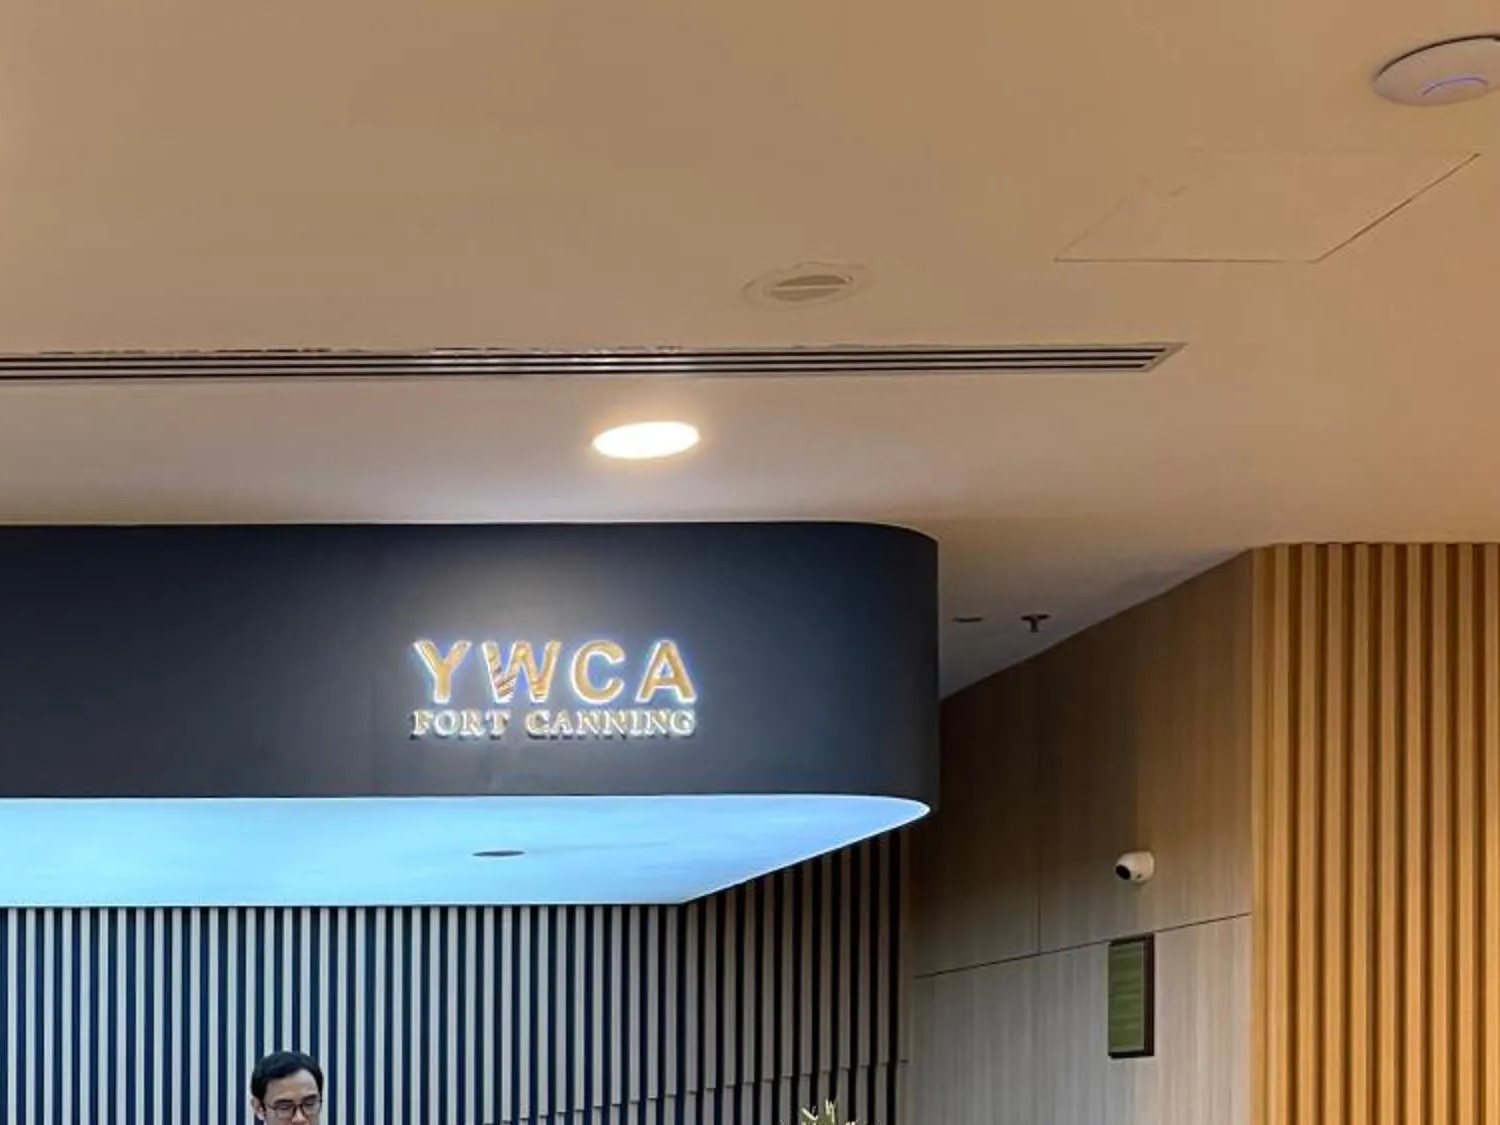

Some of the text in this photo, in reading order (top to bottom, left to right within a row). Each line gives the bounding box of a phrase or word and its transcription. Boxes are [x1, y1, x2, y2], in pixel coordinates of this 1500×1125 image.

[412, 639, 697, 704] YWCA
[411, 708, 696, 738] FORT CANNING
